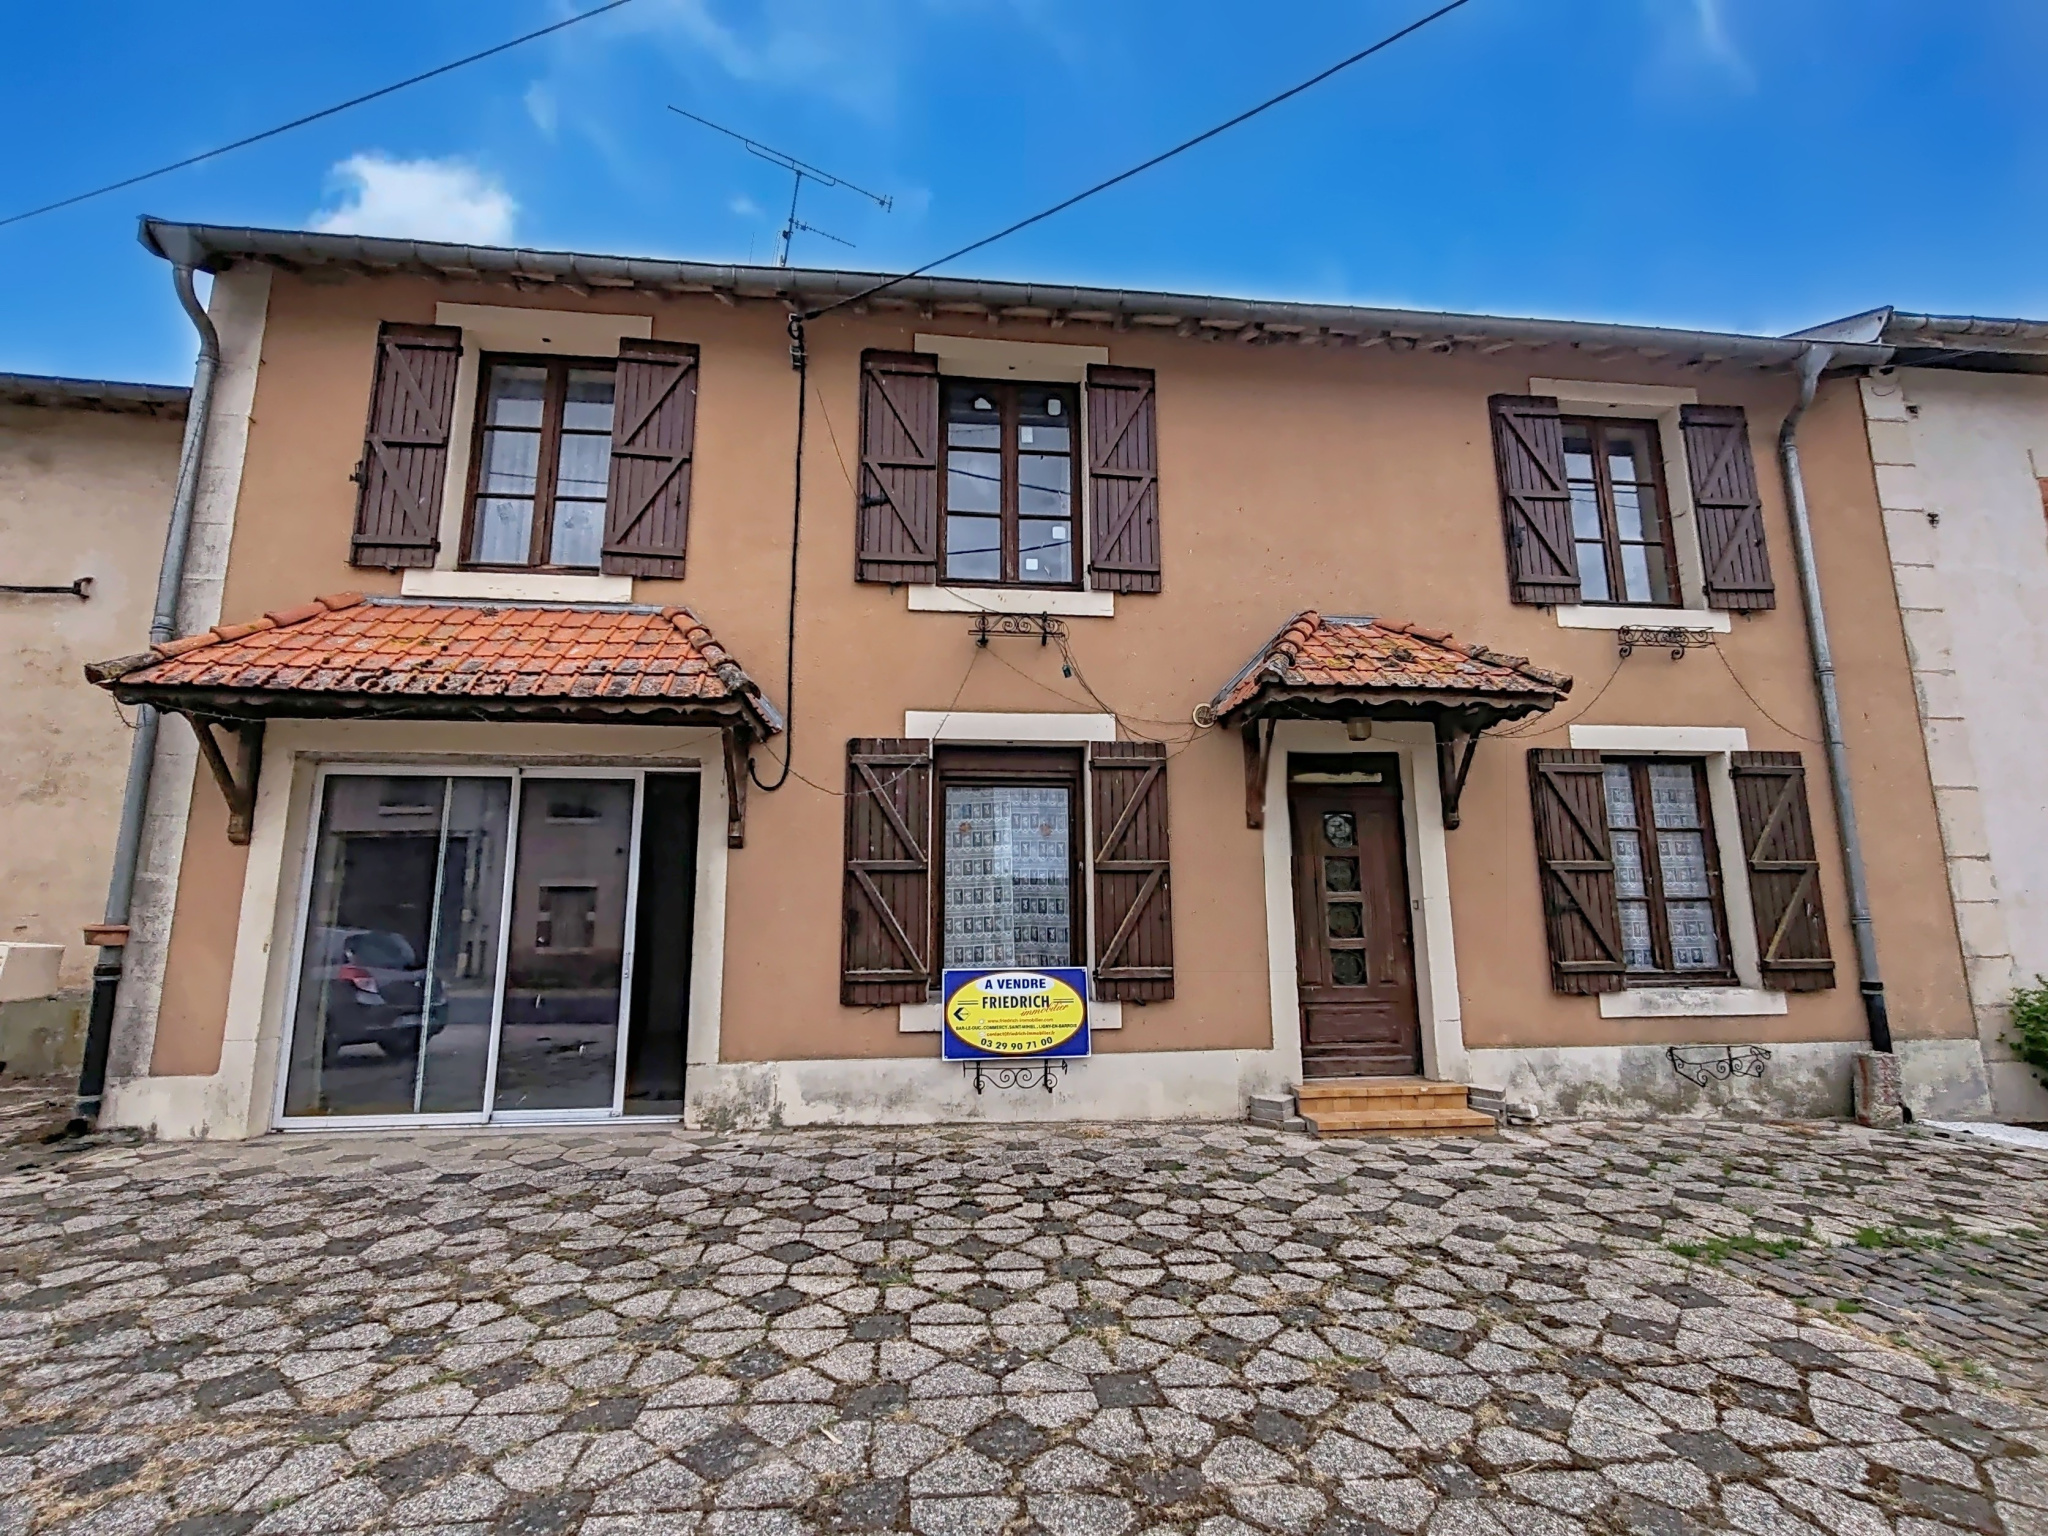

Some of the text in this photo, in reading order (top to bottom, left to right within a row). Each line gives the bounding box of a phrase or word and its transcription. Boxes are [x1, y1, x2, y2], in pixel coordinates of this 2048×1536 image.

[985, 978, 1047, 989] A VENDRE
[982, 995, 1050, 1009] FRIEDRICH
[1020, 1002, 1069, 1017] immobilier
[980, 1036, 1053, 1051] 03 29 90 71 00
